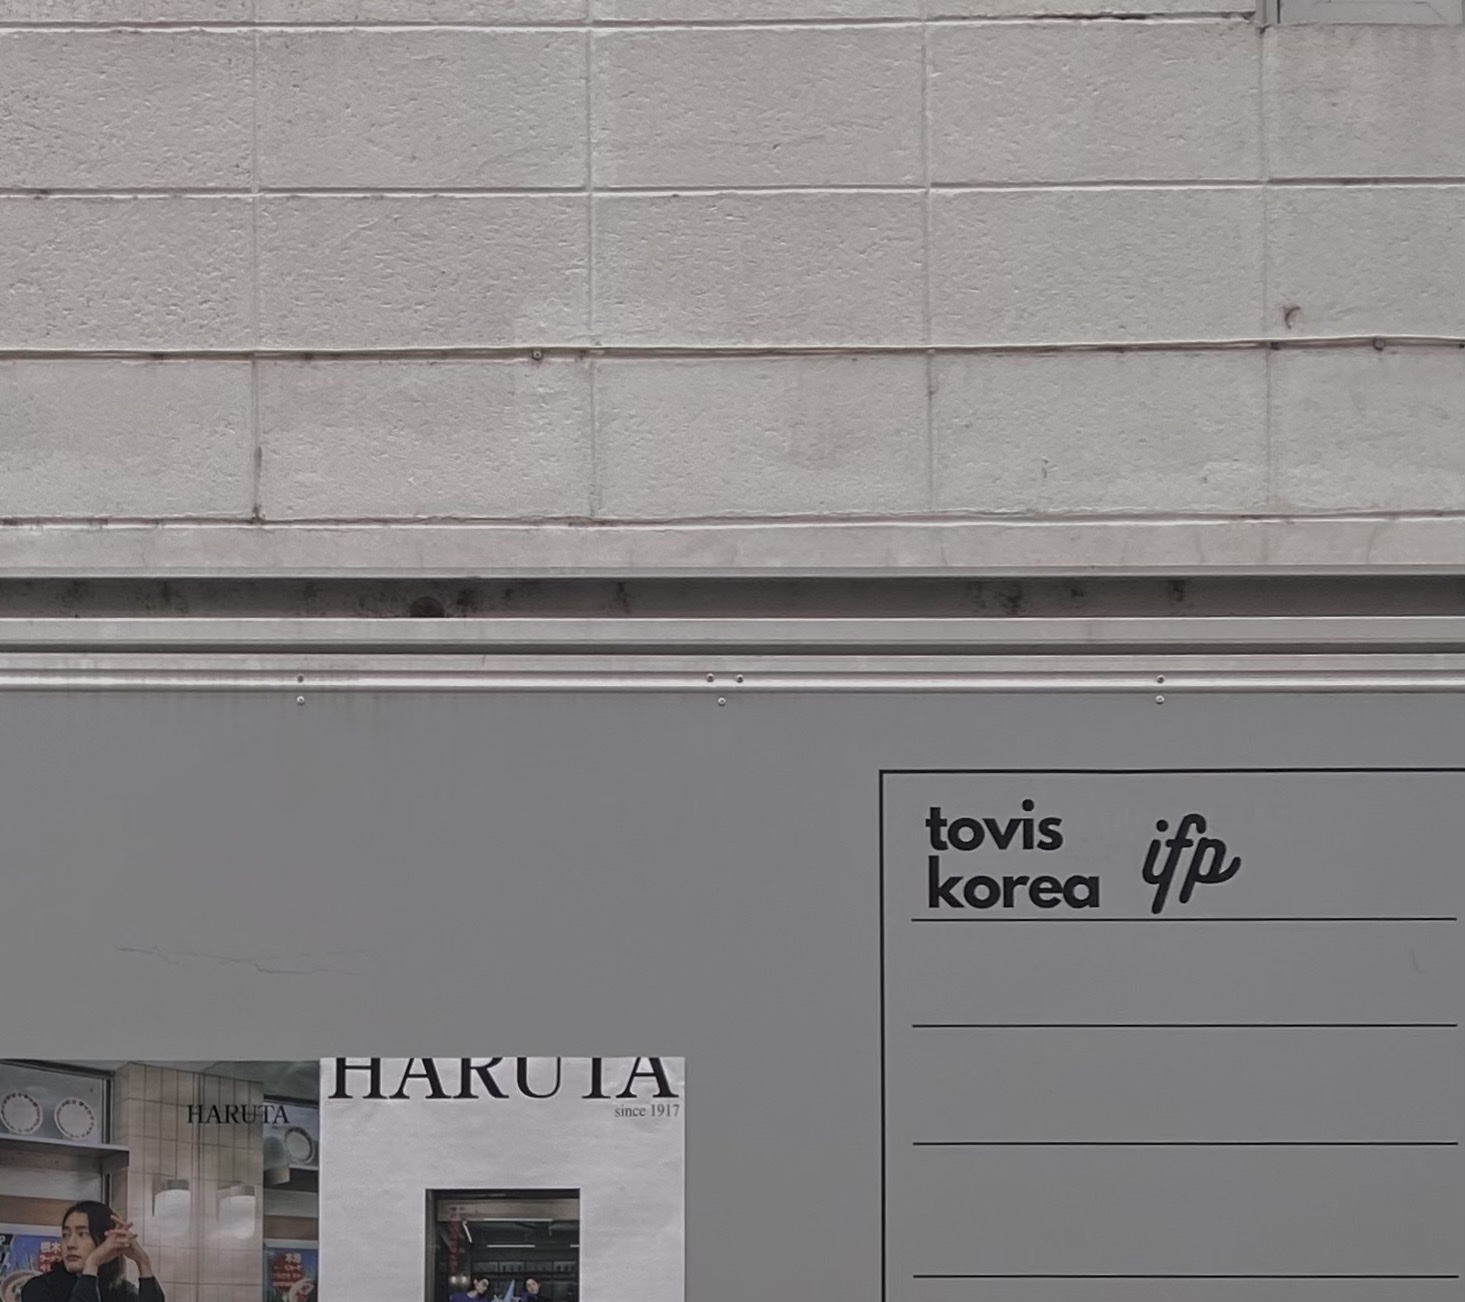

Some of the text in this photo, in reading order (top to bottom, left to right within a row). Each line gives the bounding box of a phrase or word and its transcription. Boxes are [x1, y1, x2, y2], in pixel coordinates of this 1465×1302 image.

[925, 799, 1064, 851] tovis
[928, 855, 1100, 909] korea
[1142, 813, 1242, 915] ifp
[187, 1104, 290, 1124] HARUTA
[614, 1104, 680, 1118] since 1917
